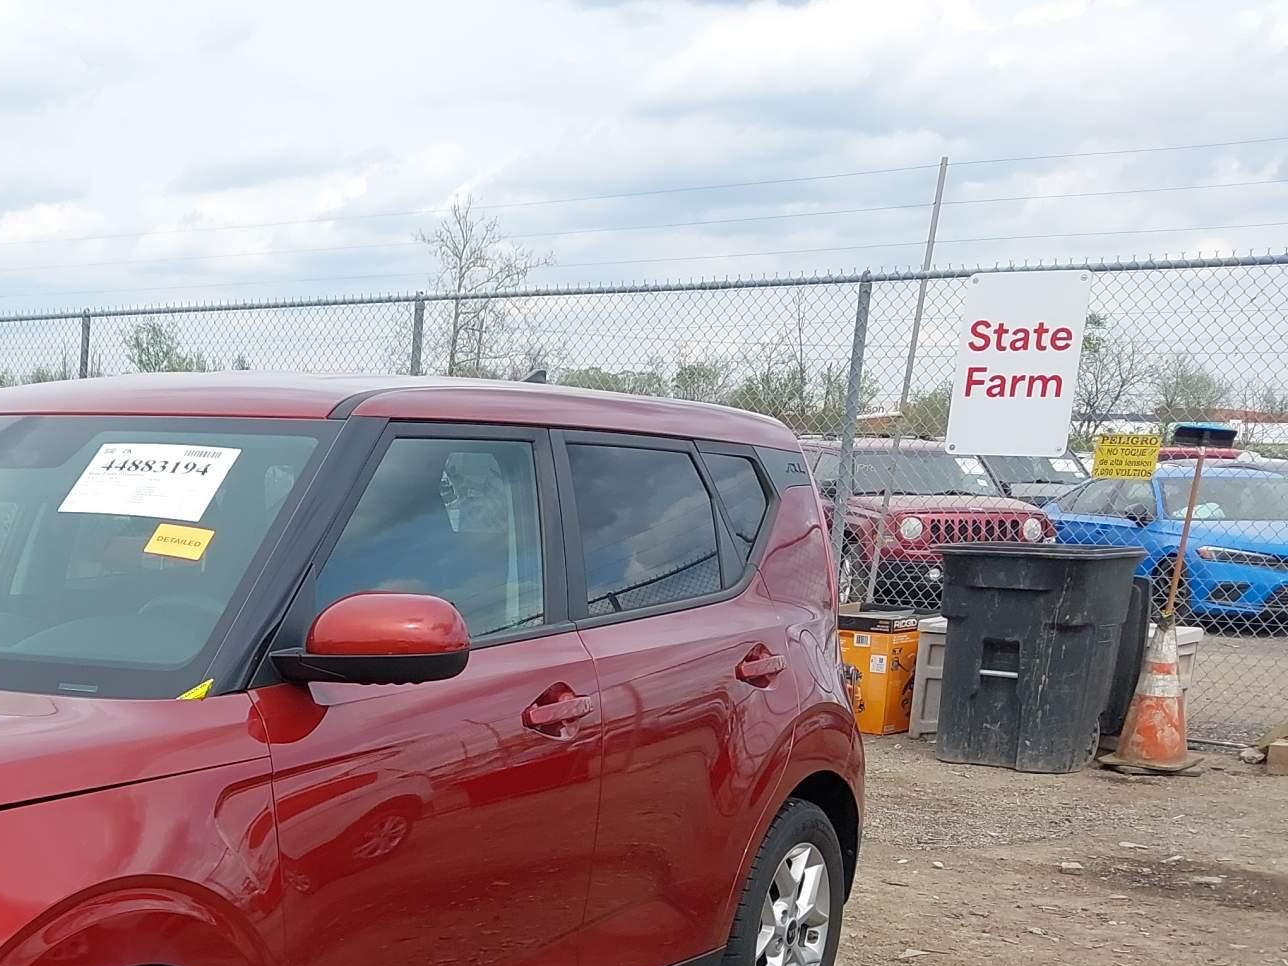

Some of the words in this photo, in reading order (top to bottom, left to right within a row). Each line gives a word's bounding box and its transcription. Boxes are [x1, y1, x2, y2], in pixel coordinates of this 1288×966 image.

[968, 320, 1073, 351] State
[964, 367, 1062, 397] Farm
[1101, 435, 1159, 445] PELIGRO
[1106, 448, 1118, 456] NO
[1120, 448, 1147, 456] TOQUE
[101, 458, 212, 476] 44883194
[1116, 468, 1153, 477] VOLTIOS
[156, 535, 202, 547] DETAILED
